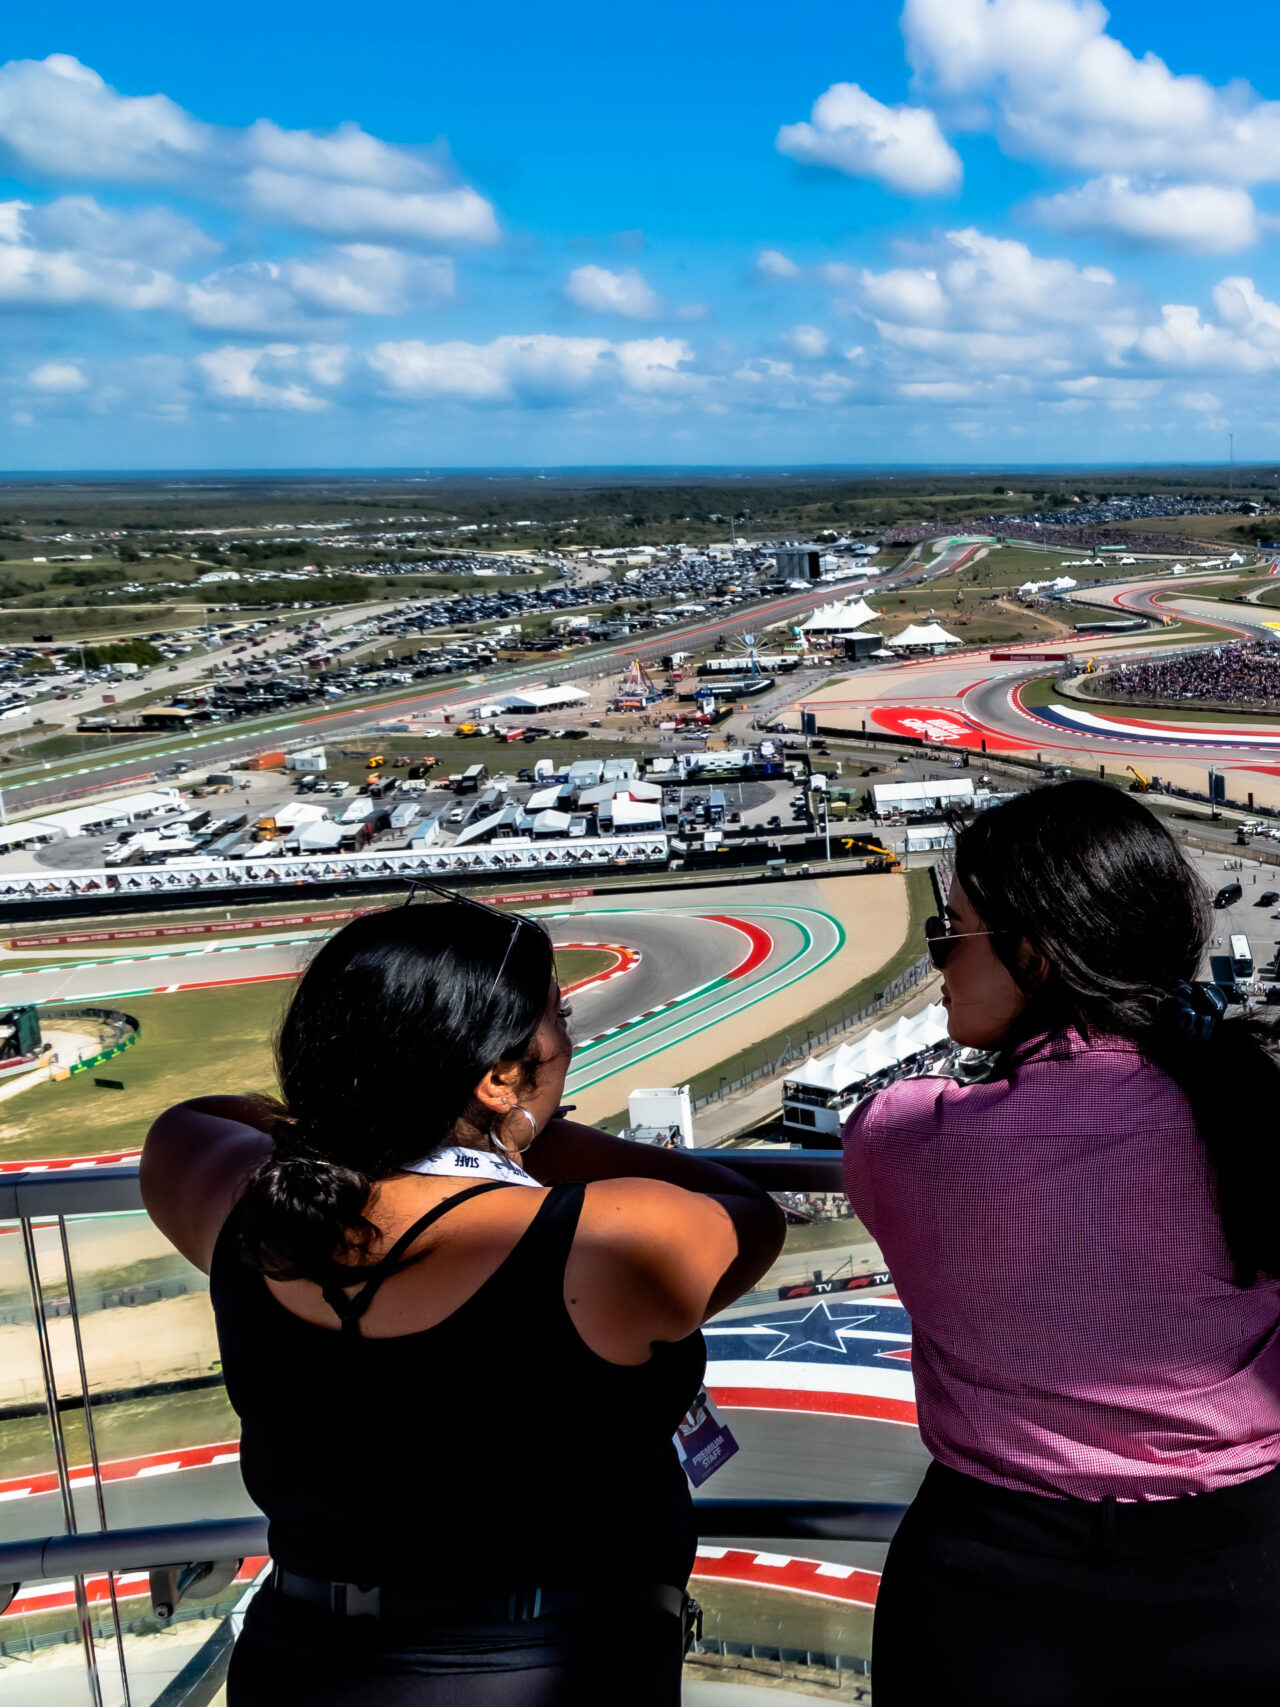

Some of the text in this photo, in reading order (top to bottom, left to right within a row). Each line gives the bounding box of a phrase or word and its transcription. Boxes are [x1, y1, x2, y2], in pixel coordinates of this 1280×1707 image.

[454, 1155, 480, 1168] STAFF
[874, 1274, 889, 1284] TV
[815, 1283, 832, 1292] TV
[692, 1435, 725, 1466] PREMIUM
[702, 1447, 722, 1468] STAFF
